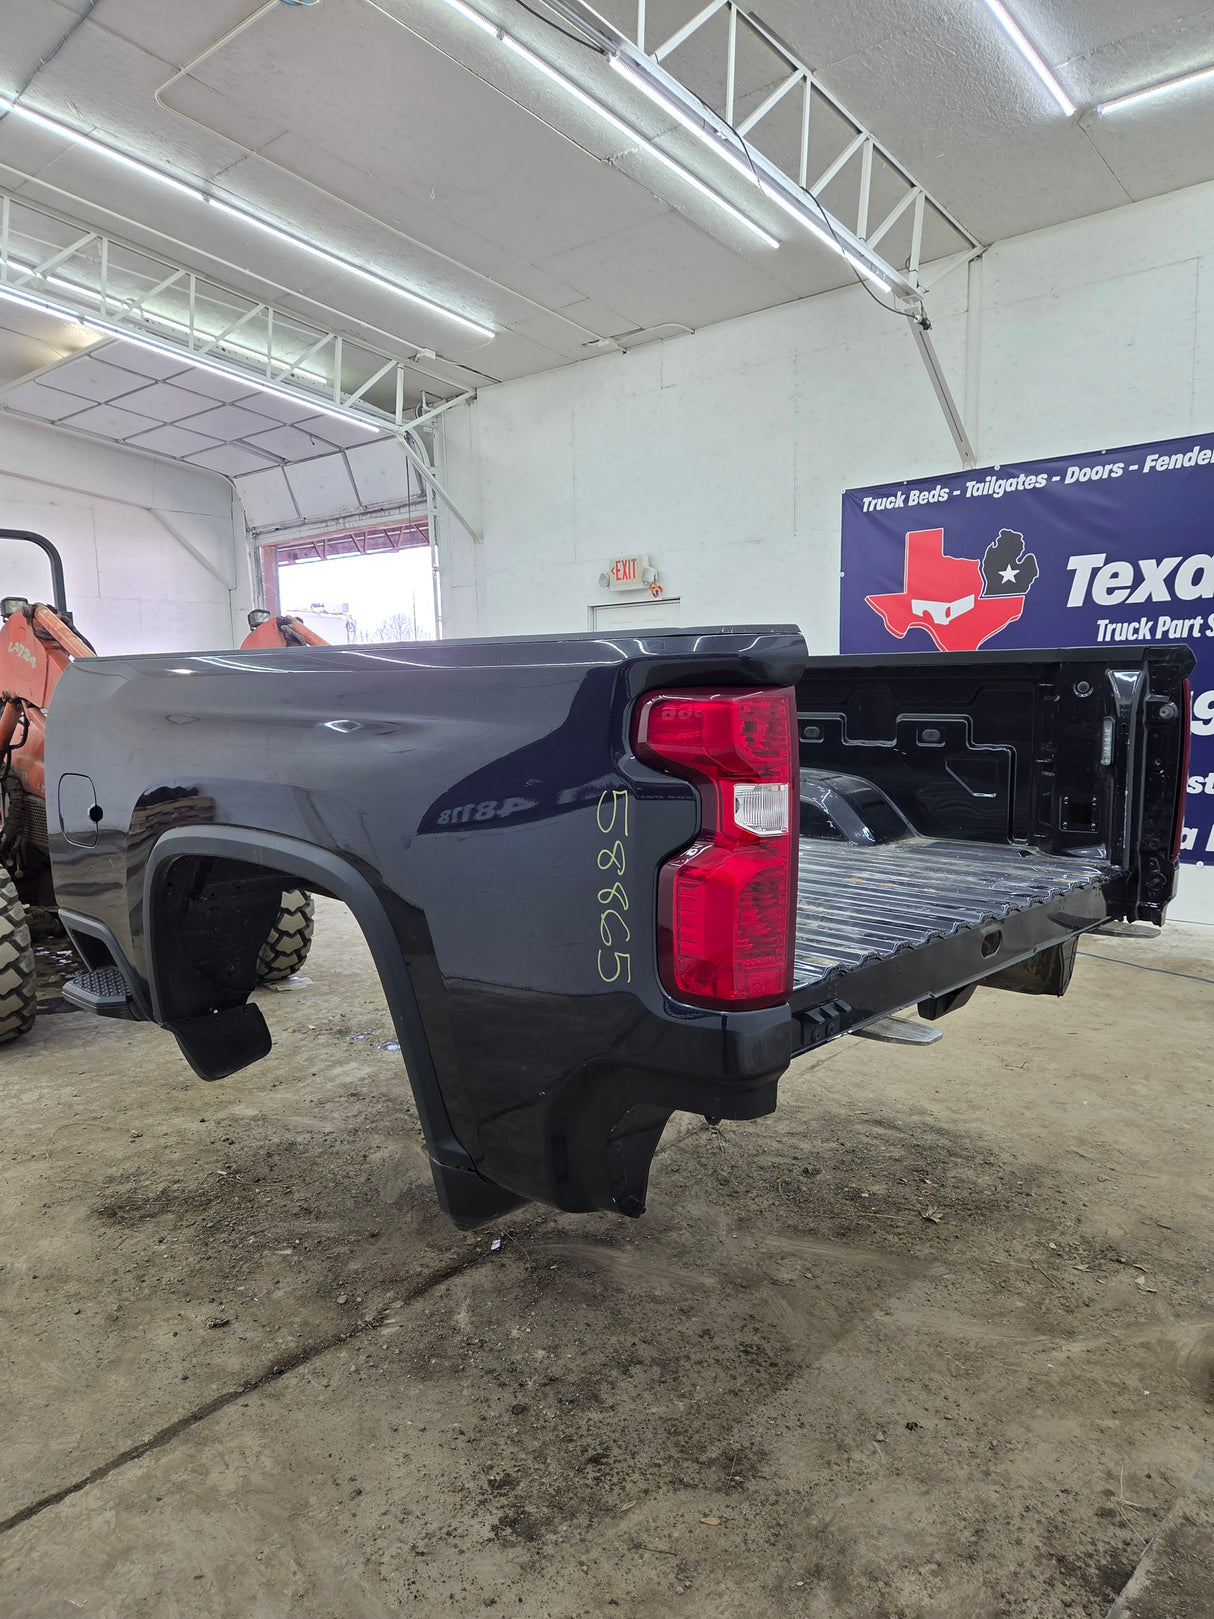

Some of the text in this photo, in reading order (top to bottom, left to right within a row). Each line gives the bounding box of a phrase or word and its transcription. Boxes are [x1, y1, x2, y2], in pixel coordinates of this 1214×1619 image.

[862, 491, 906, 512] Truck
[908, 485, 950, 506] Beds
[965, 473, 1048, 498] Tailgates
[1064, 462, 1124, 484] Doors
[615, 558, 637, 581] EXIT
[1097, 617, 1154, 642] Truck
[1155, 616, 1203, 640] Part
[596, 790, 631, 984] 58865
